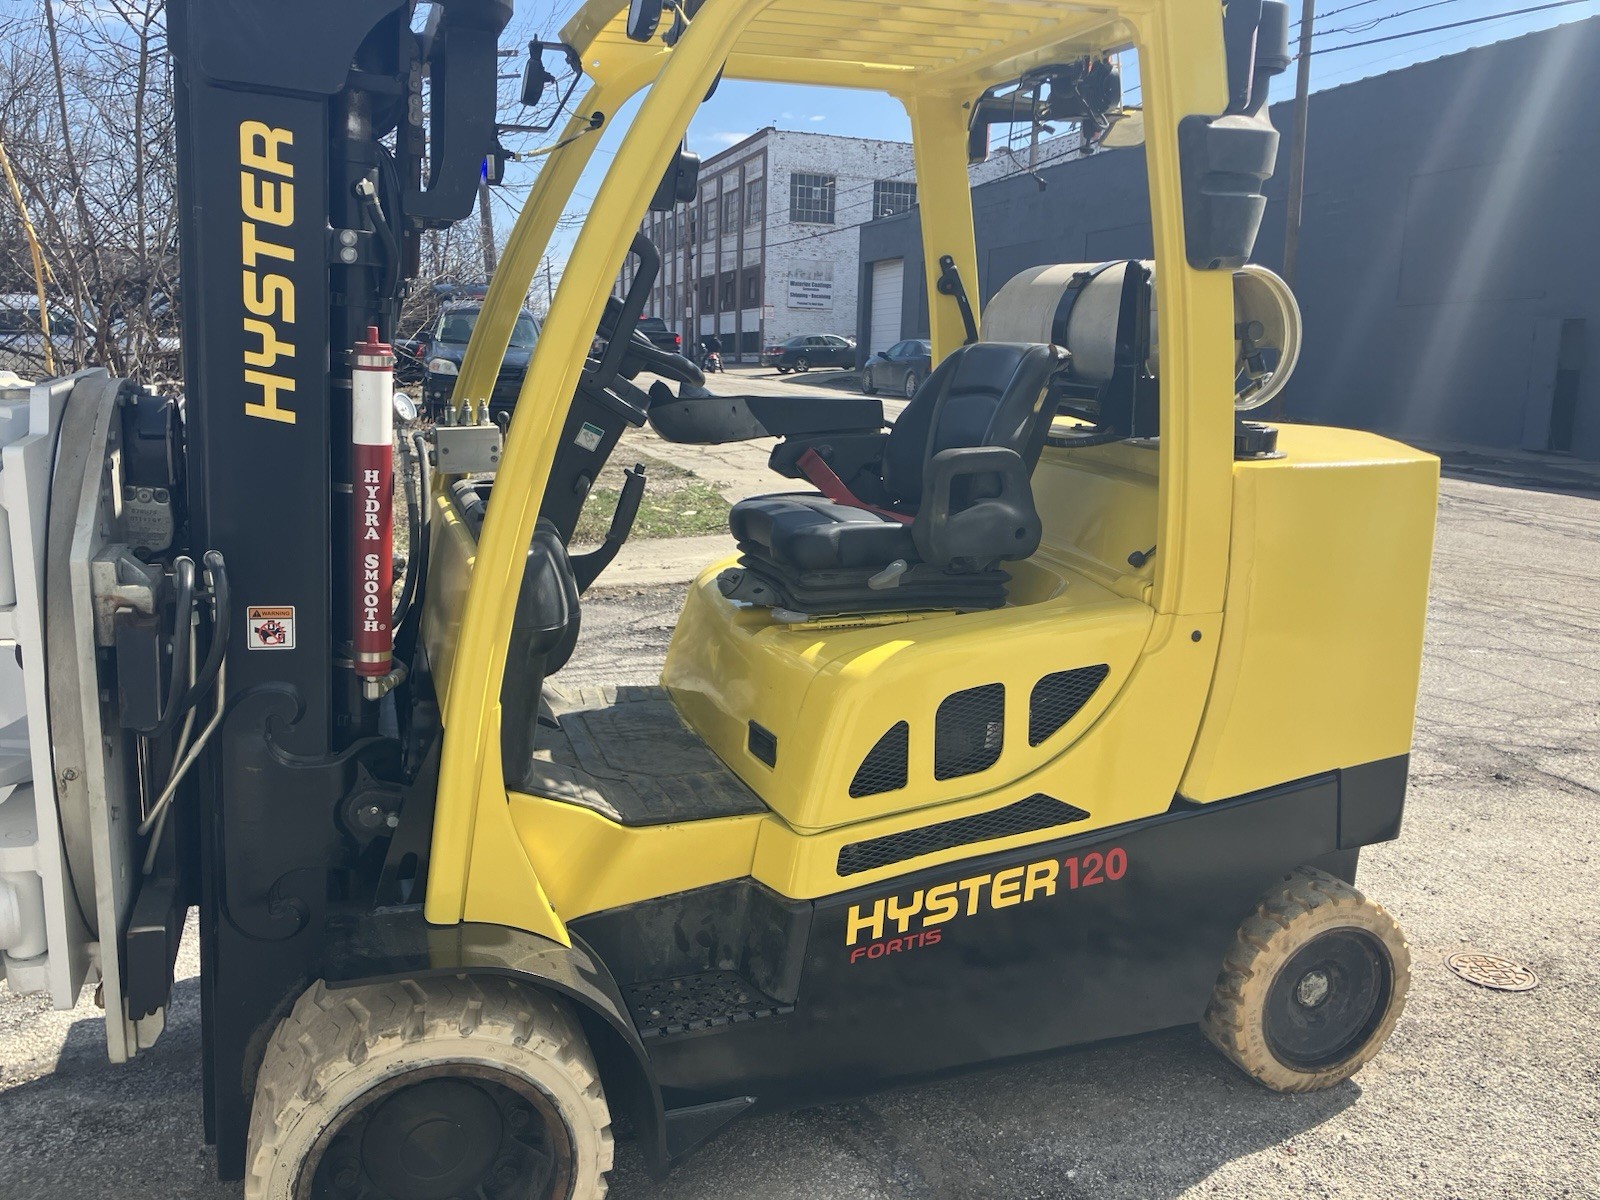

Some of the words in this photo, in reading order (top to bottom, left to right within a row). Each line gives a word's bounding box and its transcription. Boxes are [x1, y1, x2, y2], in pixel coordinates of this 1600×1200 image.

[240, 120, 296, 424] HYSTER
[364, 470, 380, 540] HYDRA
[846, 859, 1060, 946] HYSTER
[1064, 847, 1128, 890] 120
[850, 928, 942, 964] FORTIS
